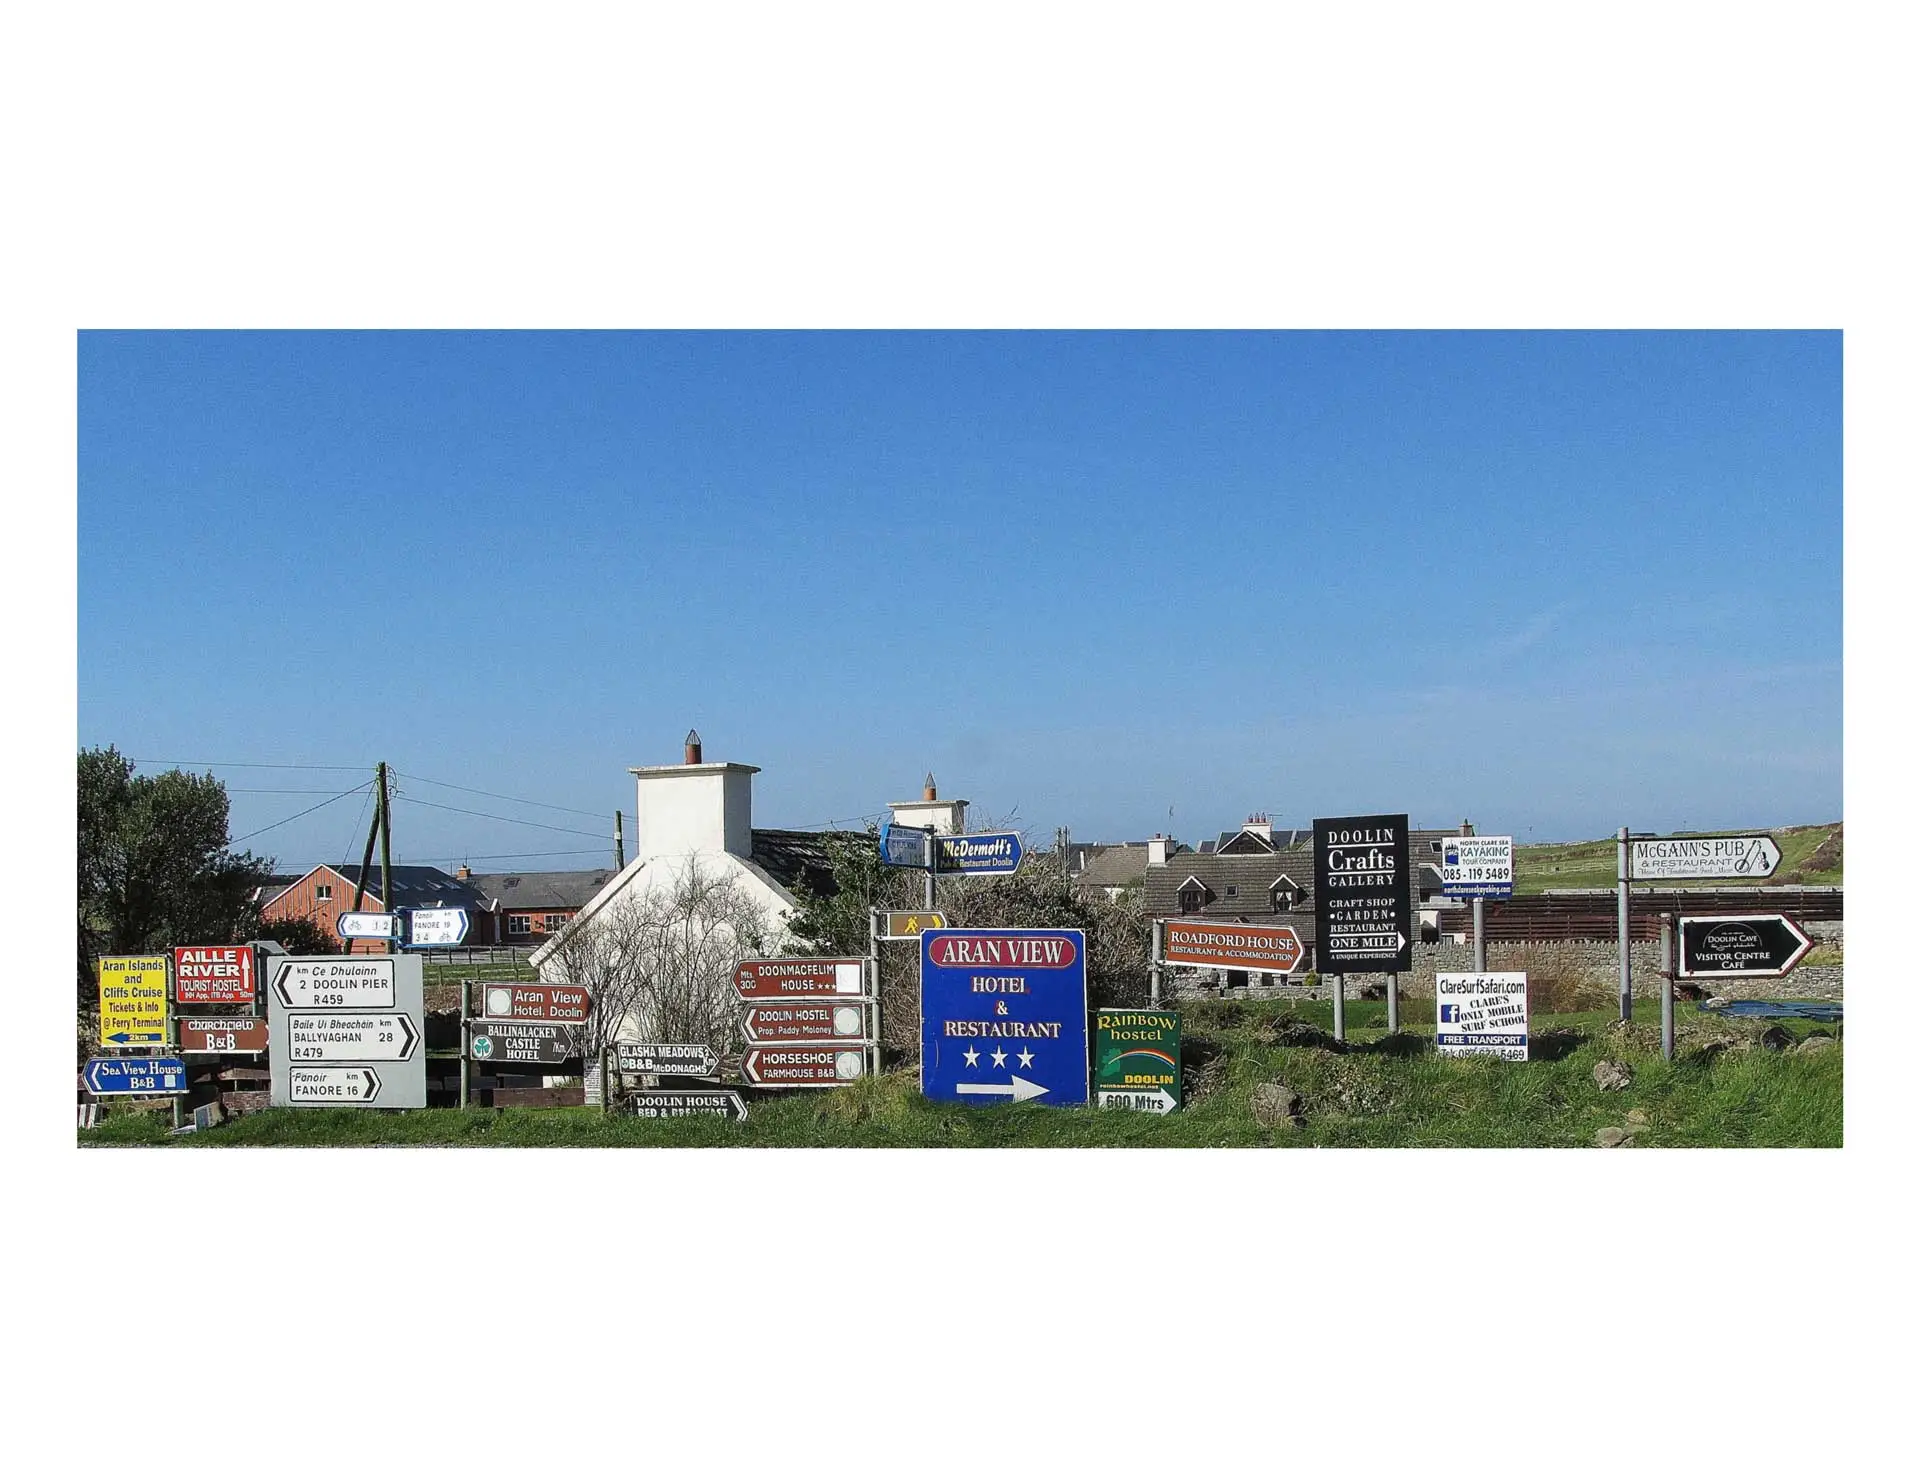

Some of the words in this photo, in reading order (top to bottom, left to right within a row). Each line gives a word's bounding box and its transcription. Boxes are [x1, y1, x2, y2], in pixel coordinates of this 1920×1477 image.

[1328, 829, 1394, 843] DOOLIN
[942, 839, 1011, 856] McDermott's
[1461, 847, 1509, 856] KAYAKING
[1638, 842, 1711, 858] McGANN'S
[1715, 841, 1744, 856] PUB
[960, 860, 991, 868] Restaurant
[992, 858, 1013, 866] Doolin
[1328, 848, 1394, 870] Crafts
[1444, 869, 1460, 880] 085
[1469, 869, 1482, 879] 119
[1486, 868, 1509, 879] 5489
[1329, 875, 1394, 887] GALLERY
[1330, 899, 1363, 907] CRAFT
[1337, 910, 1388, 920] GARDEN
[384, 922, 388, 930] 2
[1331, 923, 1396, 932] RESTAURANT
[1171, 931, 1244, 946] ROADFORD
[1248, 937, 1294, 950] HOUSE
[1330, 938, 1358, 948] ONE
[1362, 937, 1396, 947] MILE
[181, 951, 236, 962] AILLE
[942, 940, 1000, 963] ARAN
[1004, 940, 1064, 963] VIEW
[1171, 946, 1216, 955] RESTAURANT
[1225, 950, 1293, 961] ACCOMMODATION
[1336, 953, 1358, 961] UNIQUE
[1734, 952, 1770, 960] CENTRE
[103, 960, 125, 971] Aran
[129, 960, 163, 970] Islands
[180, 965, 240, 976] RIVER
[758, 965, 834, 976] DOONMACFELIM
[124, 974, 142, 983] and
[300, 981, 306, 989] 2
[314, 980, 357, 989] DOOLIN
[362, 979, 388, 989] PIER
[180, 980, 211, 991] TOURIST
[213, 980, 242, 991] HOSTEL
[781, 980, 814, 990] HOUSE
[971, 976, 1031, 993] HOTEL
[1440, 979, 1525, 994] ClareSurfSafari.com
[104, 988, 128, 998] Cliffs
[132, 987, 162, 997] Cruise
[515, 990, 543, 1002] Aran
[551, 991, 582, 1003] View
[314, 995, 343, 1004] R459
[1470, 995, 1509, 1009] CLARE'S
[109, 1003, 135, 1012] Tickets
[138, 1003, 143, 1012] &
[145, 1002, 158, 1012] Info
[550, 1007, 582, 1017] Doolin
[995, 1000, 1008, 1015] &
[1461, 1010, 1484, 1021] ONLY
[1488, 1004, 1523, 1017] MOBILE
[760, 1011, 792, 1021] DOOLIN
[796, 1010, 829, 1020] HOSTEL
[104, 1019, 109, 1029] @
[112, 1018, 130, 1029] Ferry
[133, 1018, 164, 1027] Terminal
[293, 1020, 313, 1029] Baile
[1461, 1020, 1487, 1032] SURF
[488, 1025, 556, 1038] BALLINALACKEN
[778, 1026, 799, 1035] Paddy
[803, 1026, 832, 1035] Moloney
[944, 1021, 1062, 1038] RESTAURANT
[1111, 1030, 1163, 1040] hostel
[206, 1034, 235, 1050] B&B
[295, 1033, 361, 1042] BALLYVAGHAN
[379, 1033, 393, 1042] 28
[1444, 1036, 1464, 1044] FREE
[1467, 1036, 1521, 1044] TRANSPORT
[506, 1038, 540, 1049] CASTLE
[295, 1048, 322, 1057] R479
[507, 1050, 539, 1059] HOTEL
[620, 1047, 655, 1057] GLASHA
[658, 1047, 703, 1058] MEADOWS
[630, 1058, 652, 1069] B&B
[703, 1057, 715, 1066] Km
[763, 1053, 833, 1064] HORSESHOE
[150, 1062, 182, 1074] House
[653, 1064, 707, 1073] McDONAGHS
[764, 1069, 813, 1078] FARMHOUSE
[818, 1069, 834, 1077] B&B
[130, 1078, 155, 1088] B&B
[1125, 1075, 1173, 1084] DOOLIN
[296, 1086, 342, 1095] FANORE
[347, 1086, 358, 1095] 16
[637, 1097, 682, 1106] DOOLIN
[687, 1097, 727, 1106] HOUSE
[1106, 1095, 1130, 1109] 600
[1135, 1095, 1164, 1109] Mtrs
[638, 1108, 657, 1117] BED
[661, 1108, 668, 1117] &
